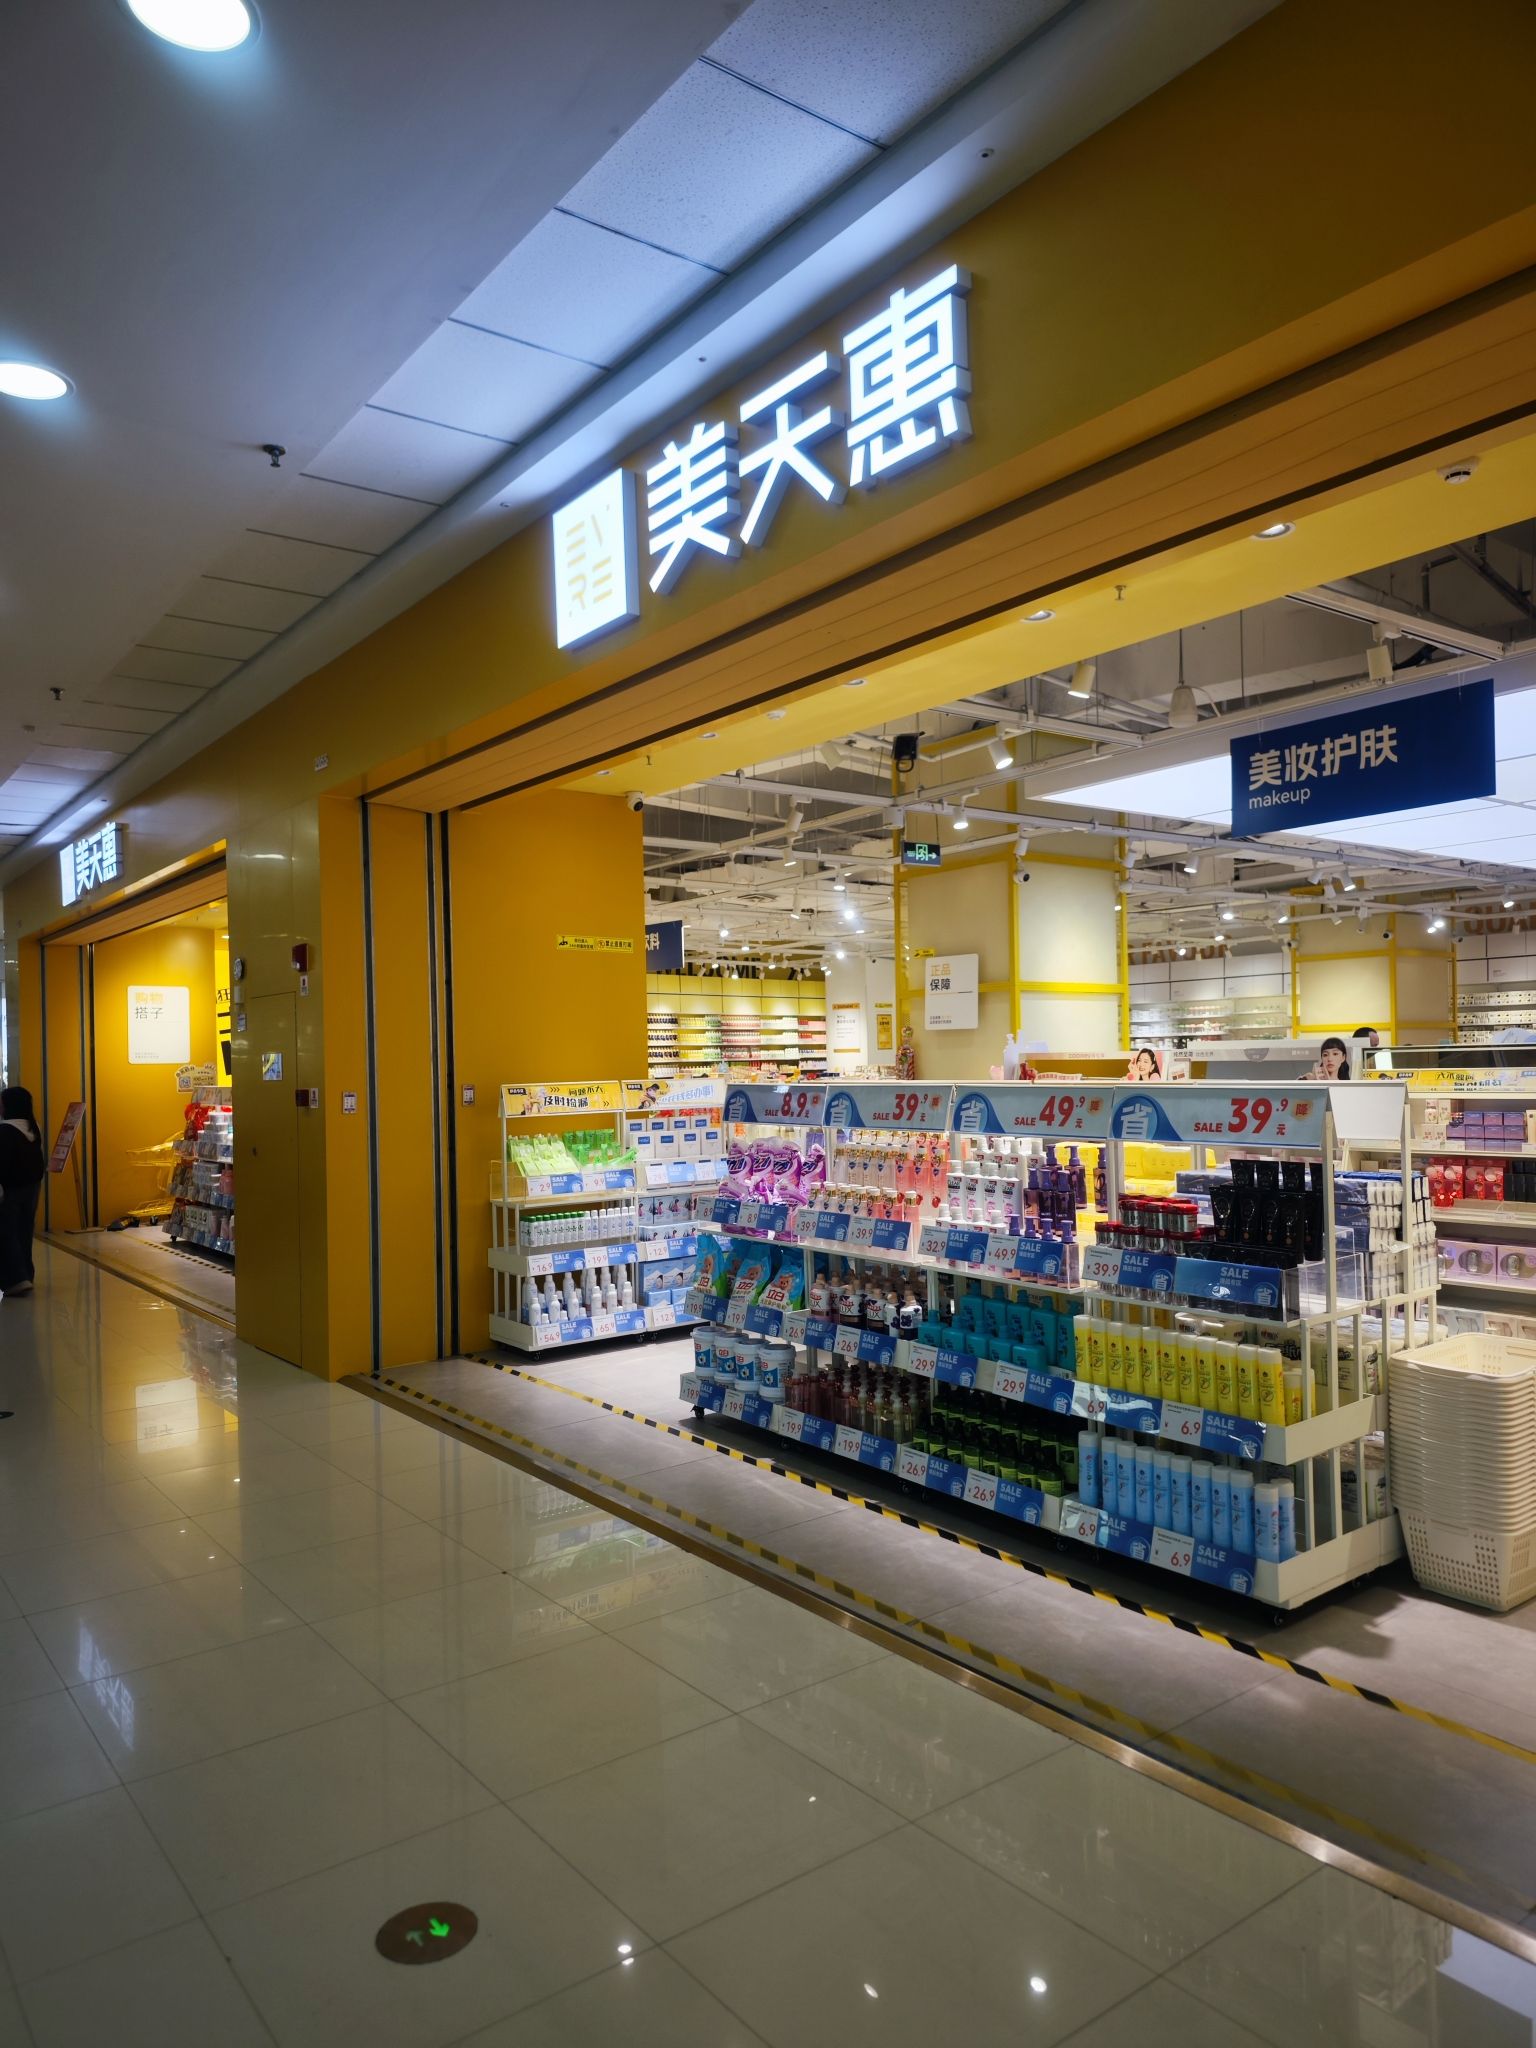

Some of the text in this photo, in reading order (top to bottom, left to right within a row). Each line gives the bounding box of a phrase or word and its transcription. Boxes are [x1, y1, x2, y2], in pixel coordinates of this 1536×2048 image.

[647, 264, 958, 593] 美天惠
[1249, 725, 1398, 791] 美妆护肤
[1249, 786, 1311, 809] makeup
[75, 822, 117, 896] 美天惠
[930, 963, 951, 976] 正品
[930, 978, 951, 991] 保障
[135, 1006, 164, 1020] 搭子
[764, 1109, 778, 1117] SALE
[829, 1096, 849, 1127] 省
[872, 1112, 890, 1121] SALE
[960, 1100, 983, 1132] 省
[1014, 1116, 1036, 1126] SALE
[1075, 1118, 1083, 1129] 元
[1121, 1103, 1152, 1139] 省
[1194, 1121, 1223, 1133] SALE
[1276, 1123, 1286, 1136] 元
[1295, 1103, 1309, 1116] 降
[820, 1215, 835, 1223] SALE
[801, 1221, 816, 1231] 39.9
[877, 1222, 894, 1231] SALE
[856, 1228, 873, 1239] 39.9
[949, 1232, 969, 1243] SALE
[926, 1240, 946, 1252] 32.9
[1020, 1241, 1041, 1252] SALE
[554, 1253, 569, 1261] SALE
[994, 1249, 1016, 1260] 49.9
[1123, 1255, 1149, 1266] SALE
[1093, 1262, 1119, 1277] 39.9
[1220, 1266, 1249, 1279] SALE
[767, 1289, 785, 1301] 立白
[755, 1309, 769, 1318] SALE
[808, 1322, 823, 1331] SALE
[863, 1334, 880, 1344] SALE
[841, 1340, 858, 1352] 26.9
[913, 1357, 935, 1371] 29.9
[937, 1353, 959, 1365] SALE
[1003, 1378, 1025, 1394] 29.9
[1029, 1373, 1052, 1388] SALE
[1087, 1400, 1105, 1413] 6.9
[804, 1418, 820, 1429] SALE
[1181, 1421, 1201, 1436] 6.9
[1206, 1415, 1235, 1430] SALE
[842, 1439, 860, 1452] 19.9
[862, 1436, 880, 1448] SALE
[906, 1461, 926, 1476] 26.9
[928, 1460, 949, 1474] SALE
[973, 1486, 995, 1501] 26.9
[1000, 1483, 1022, 1498] SALE
[1078, 1522, 1096, 1536] 6.9
[1198, 1544, 1227, 1561] SALE
[1171, 1552, 1191, 1567] 6.9
